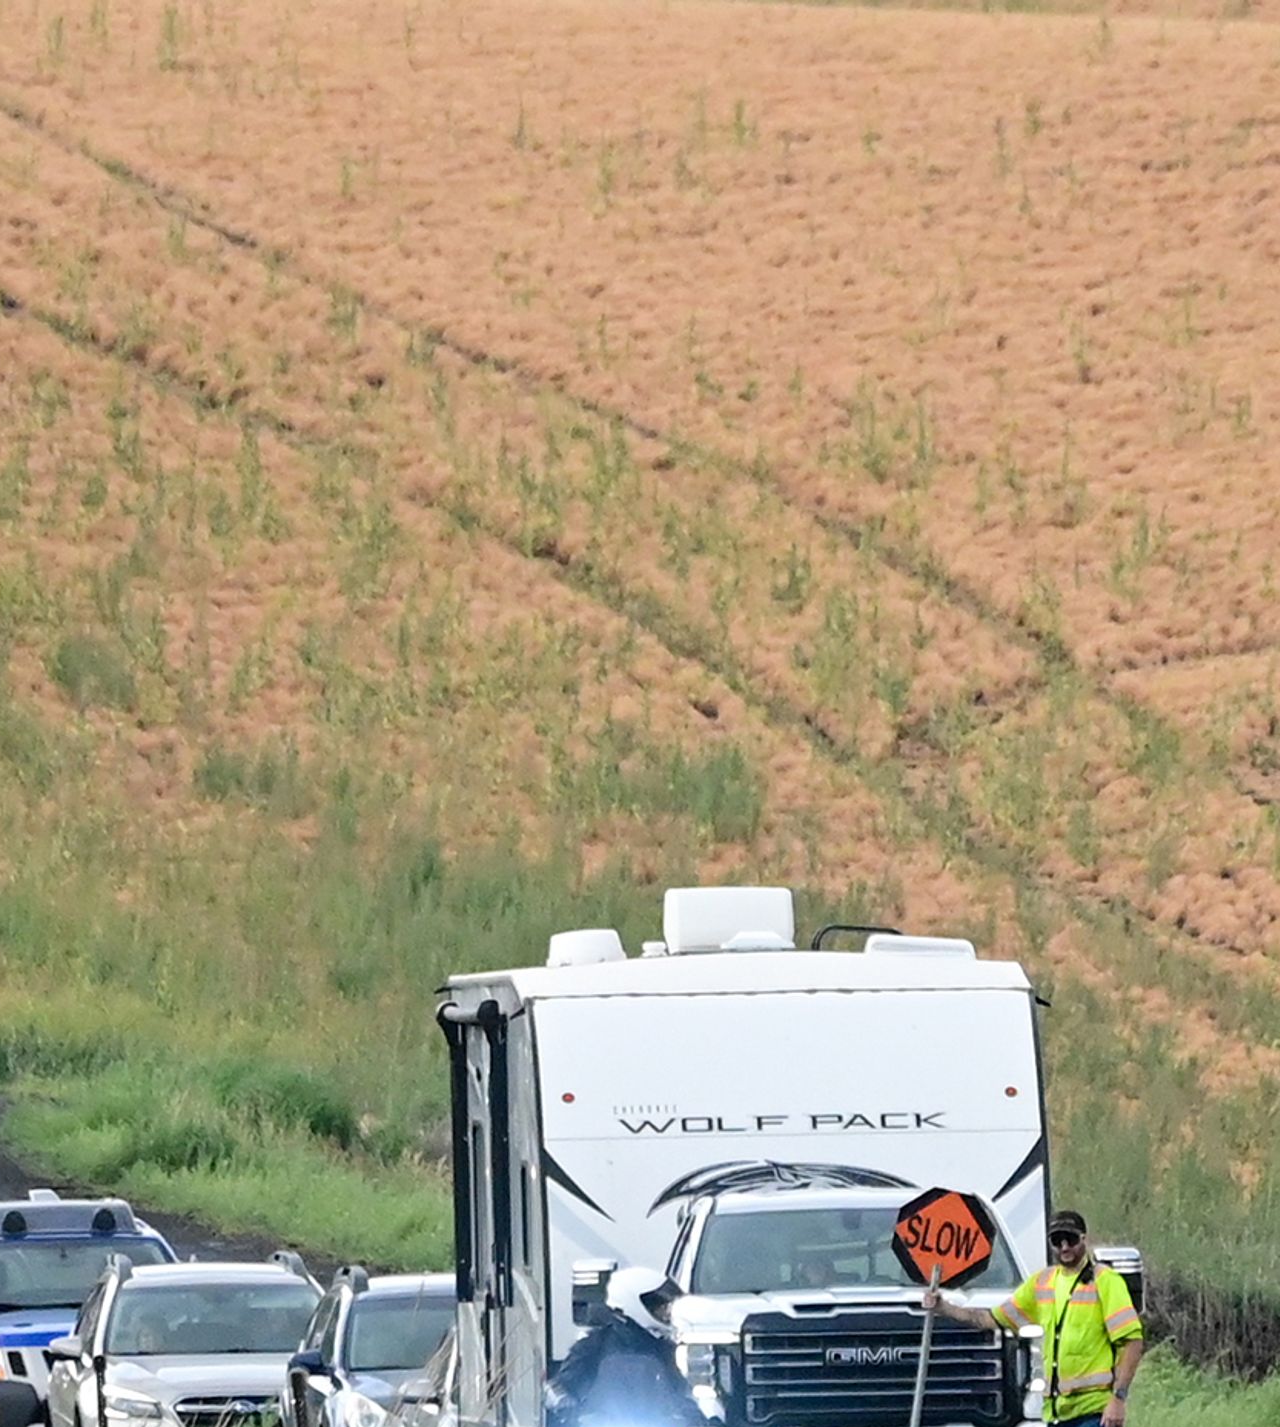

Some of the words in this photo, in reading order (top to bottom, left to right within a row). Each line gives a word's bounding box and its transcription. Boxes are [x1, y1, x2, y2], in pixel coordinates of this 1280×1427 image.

[619, 1115, 789, 1133] WOLF
[810, 1112, 946, 1130] PACK
[904, 1214, 980, 1261] SLOW
[826, 1347, 922, 1366] GMC
